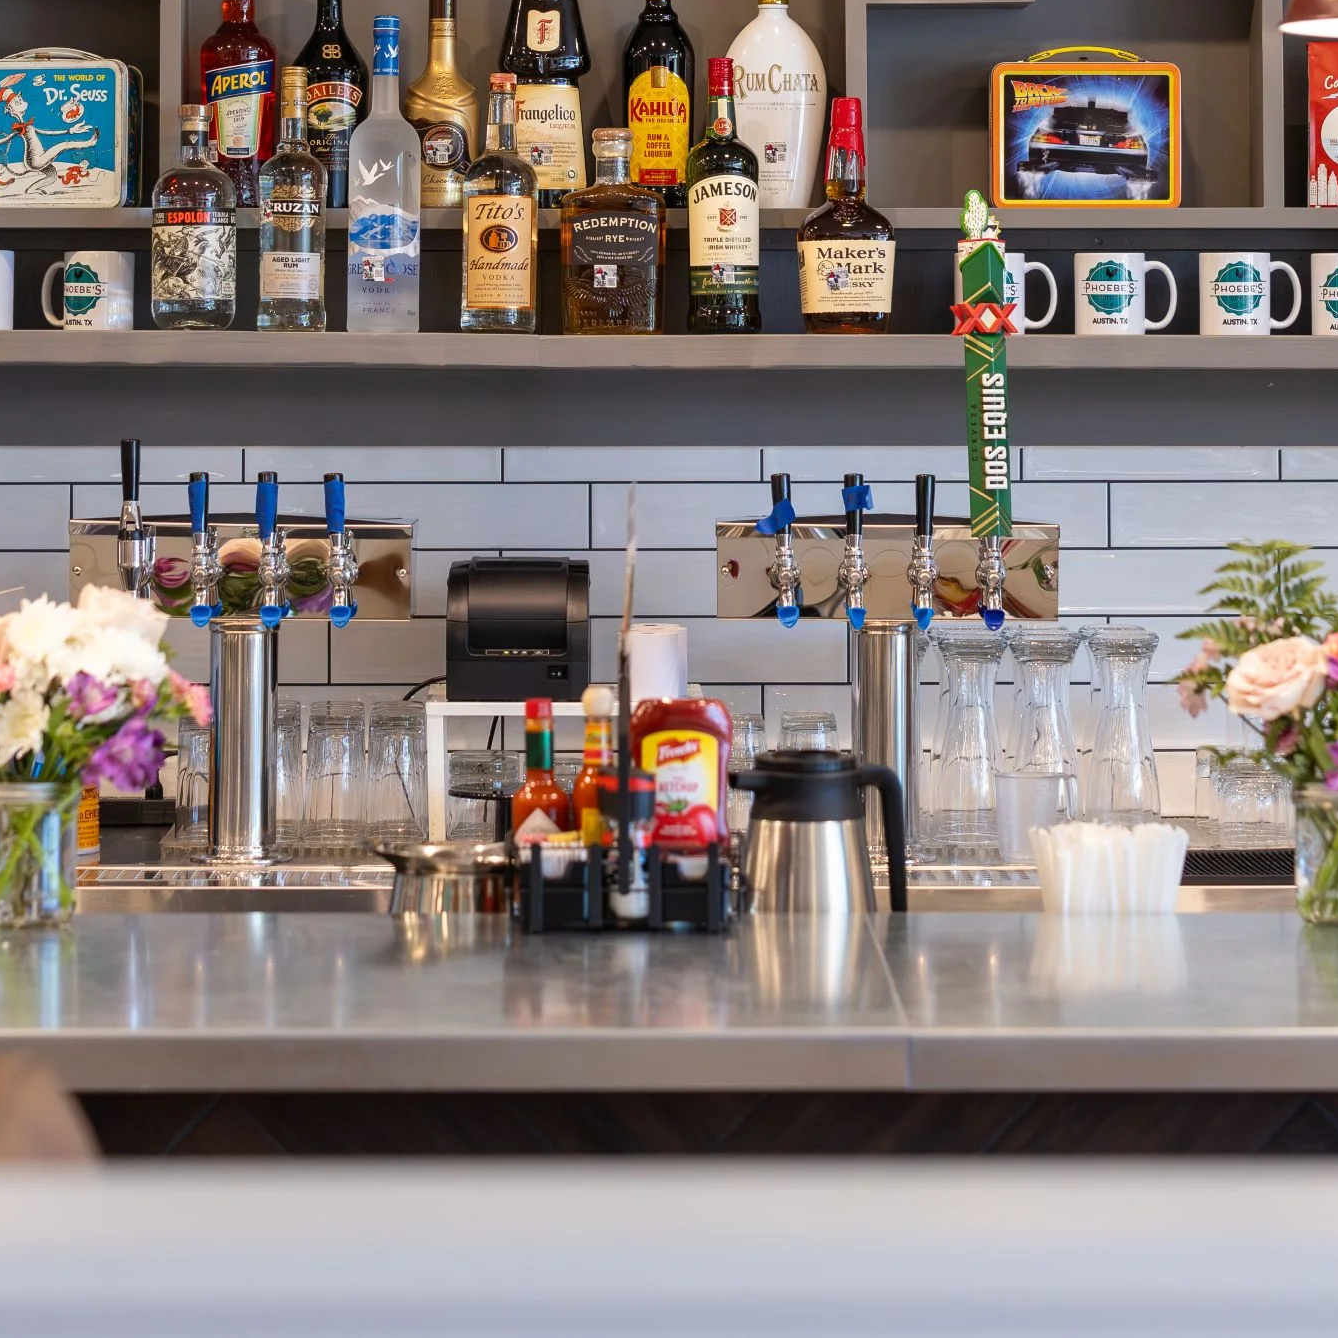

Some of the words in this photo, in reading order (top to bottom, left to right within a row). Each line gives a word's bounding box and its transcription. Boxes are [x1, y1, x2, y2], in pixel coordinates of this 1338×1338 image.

[211, 71, 266, 96] APEROL
[307, 85, 359, 101] BAILEYS
[43, 87, 68, 106] Dr.
[69, 84, 108, 102] Seuss
[515, 100, 576, 126] Frangelico
[630, 97, 686, 123] KAHLÚA
[693, 182, 757, 204] JAMESON
[475, 202, 524, 220] Tito's
[573, 217, 657, 234] REDEMPTION
[470, 256, 529, 270] Handmade
[816, 248, 885, 259] Maker's
[1085, 282, 1135, 294] PHOEBE'S
[1214, 283, 1263, 294] PHOEBE'S
[981, 373, 1008, 440] EQUIS
[985, 446, 1008, 490] DOS
